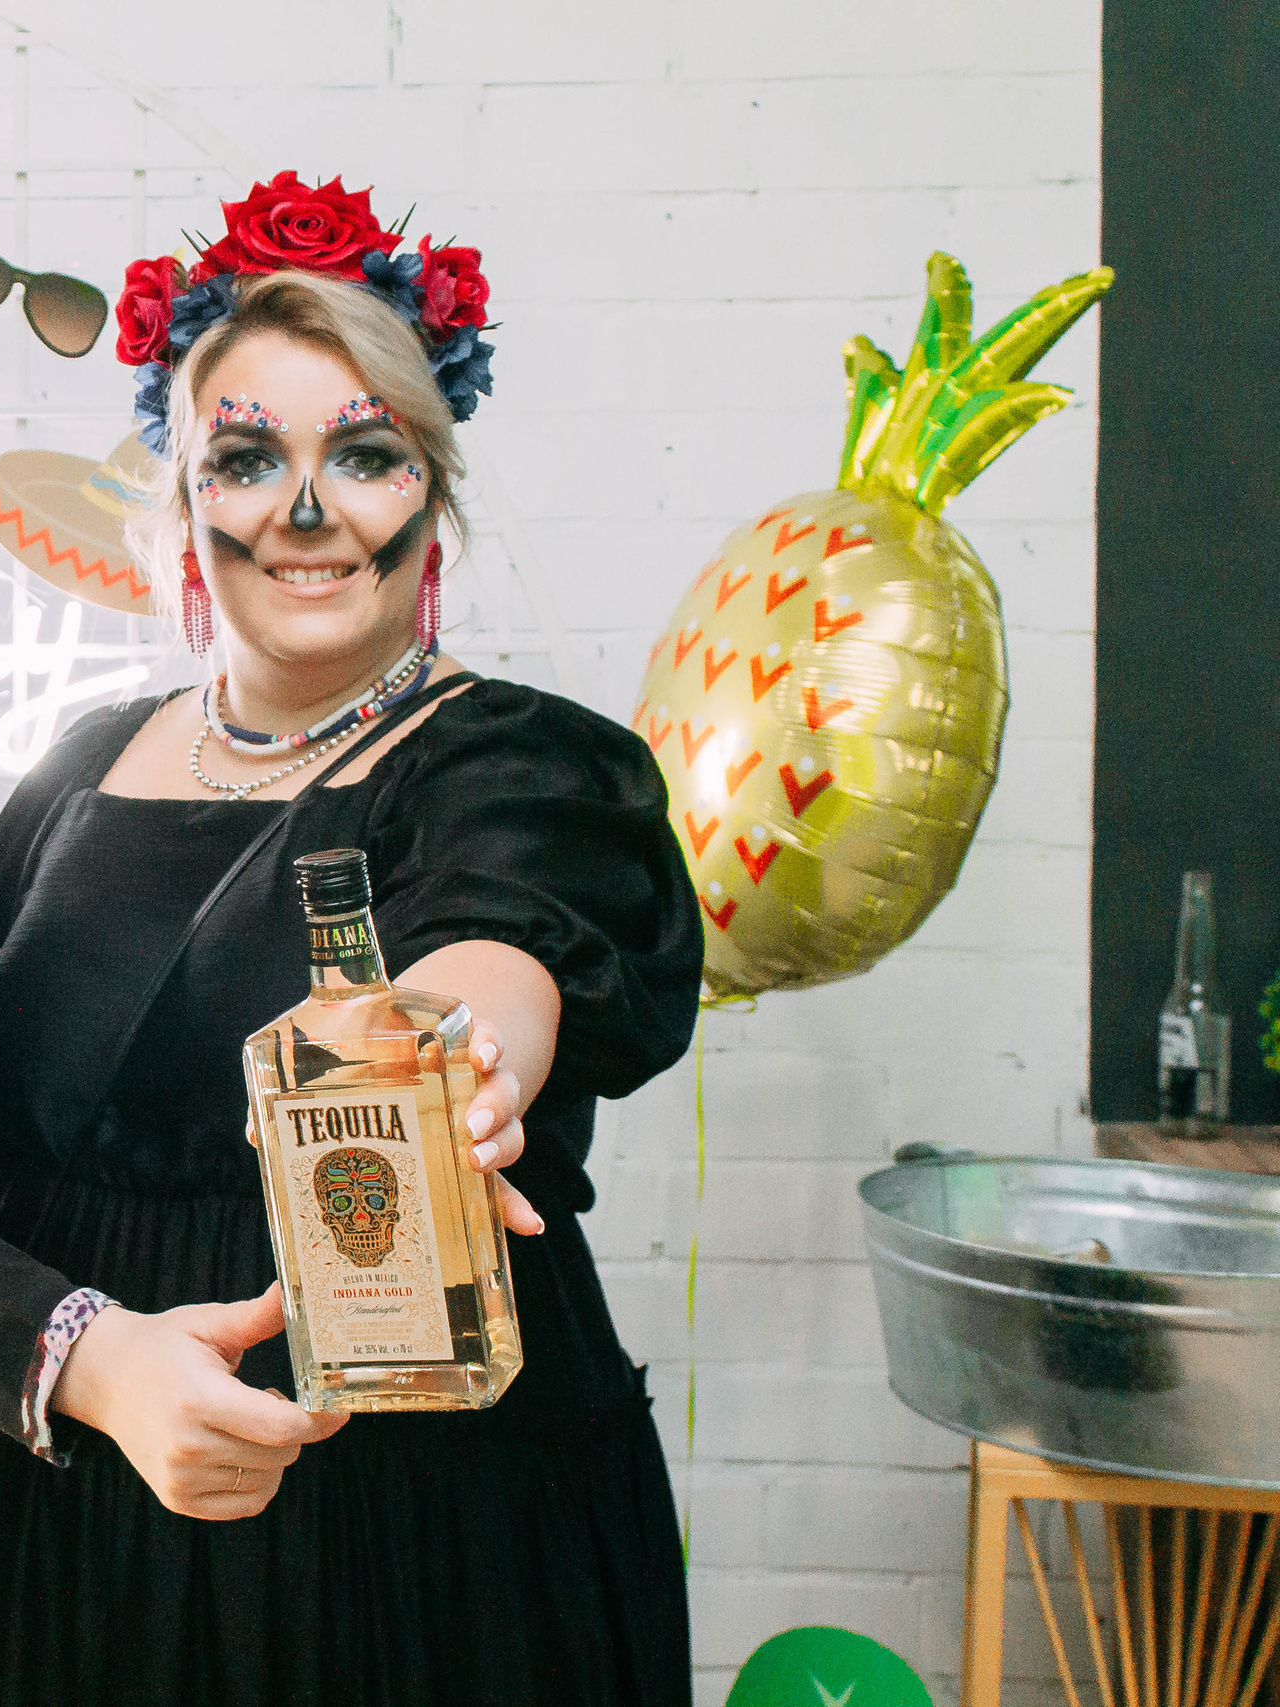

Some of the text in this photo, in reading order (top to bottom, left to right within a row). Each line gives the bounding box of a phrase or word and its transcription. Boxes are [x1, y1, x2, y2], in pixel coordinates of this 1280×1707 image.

[339, 946, 362, 958] GOLD
[285, 1104, 409, 1148] TEQUILA
[343, 1273, 398, 1285] HECHO IN MEXICO
[333, 1287, 413, 1299] INDIANA GOLD
[345, 1303, 405, 1318] Handcrafted
